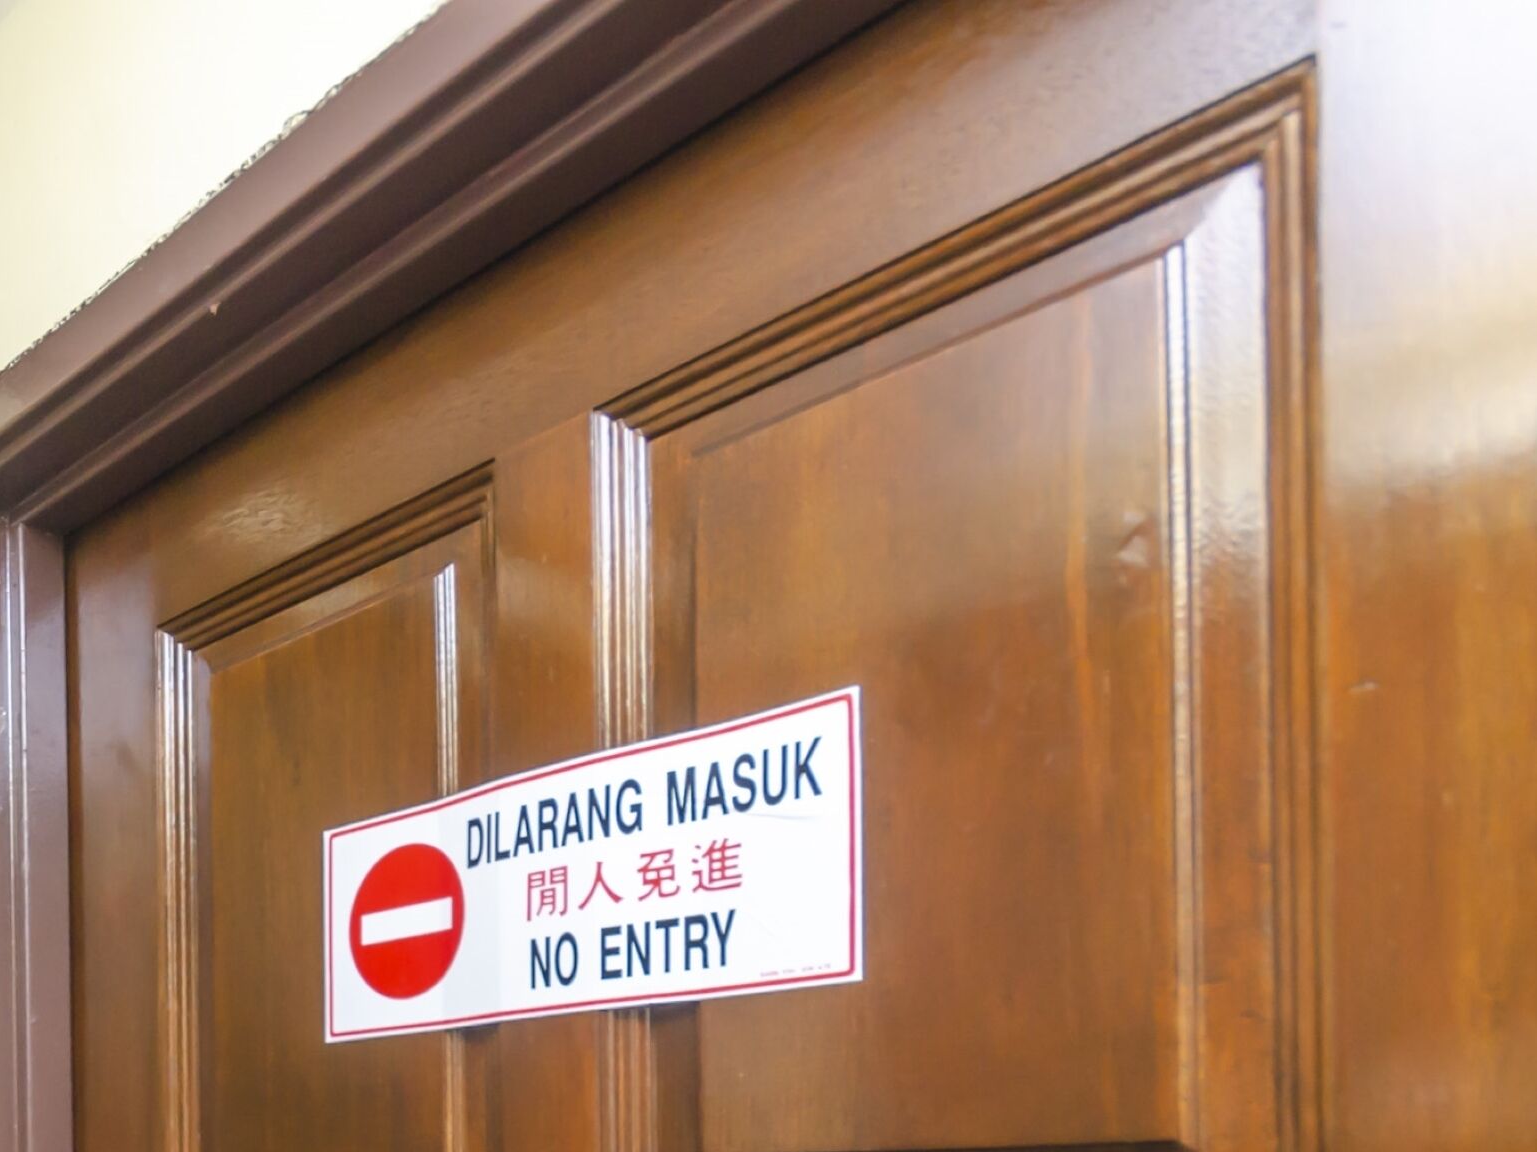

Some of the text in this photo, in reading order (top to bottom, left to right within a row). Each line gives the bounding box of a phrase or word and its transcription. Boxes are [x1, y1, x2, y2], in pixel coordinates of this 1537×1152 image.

[467, 736, 823, 869] DILARANG MASUK
[530, 909, 736, 989] NO ENTRY
